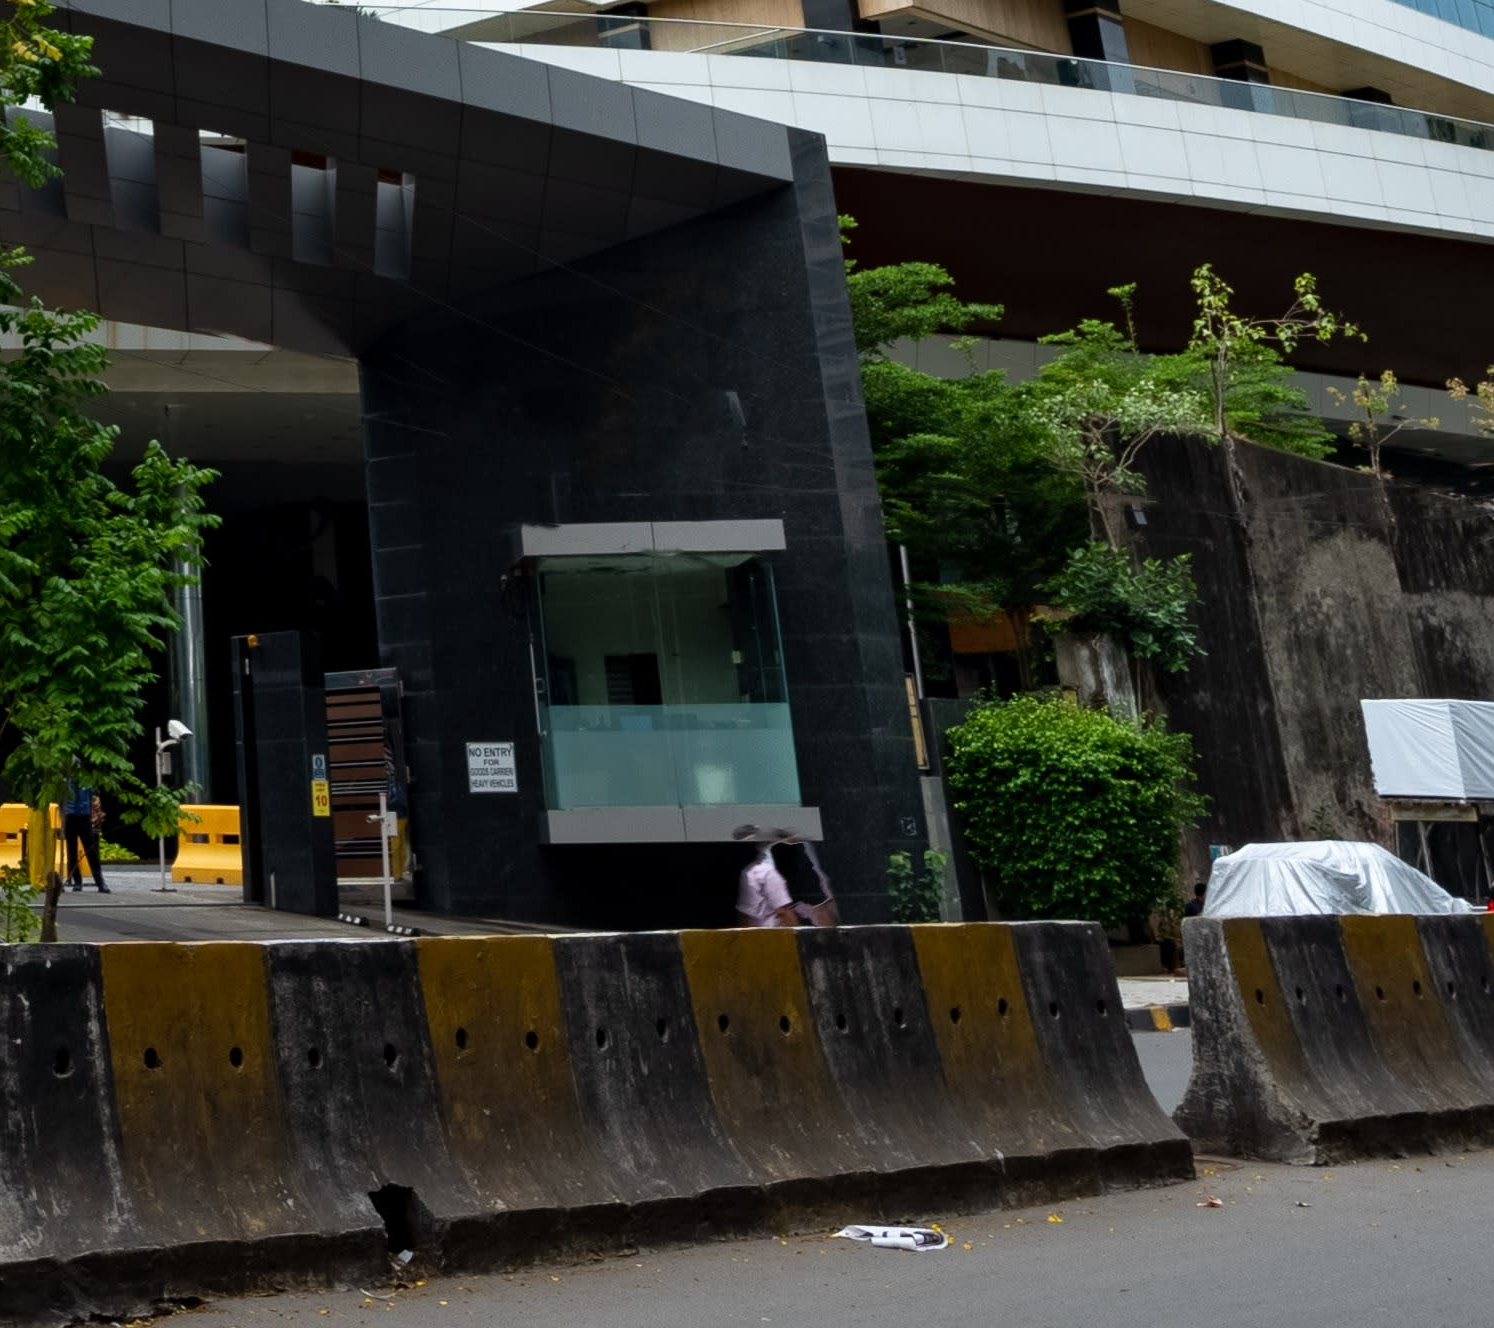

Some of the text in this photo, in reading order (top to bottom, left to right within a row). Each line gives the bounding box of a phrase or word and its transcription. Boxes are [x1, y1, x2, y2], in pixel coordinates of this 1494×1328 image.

[468, 747, 511, 757] NO ENTRY
[315, 794, 328, 807] 10
